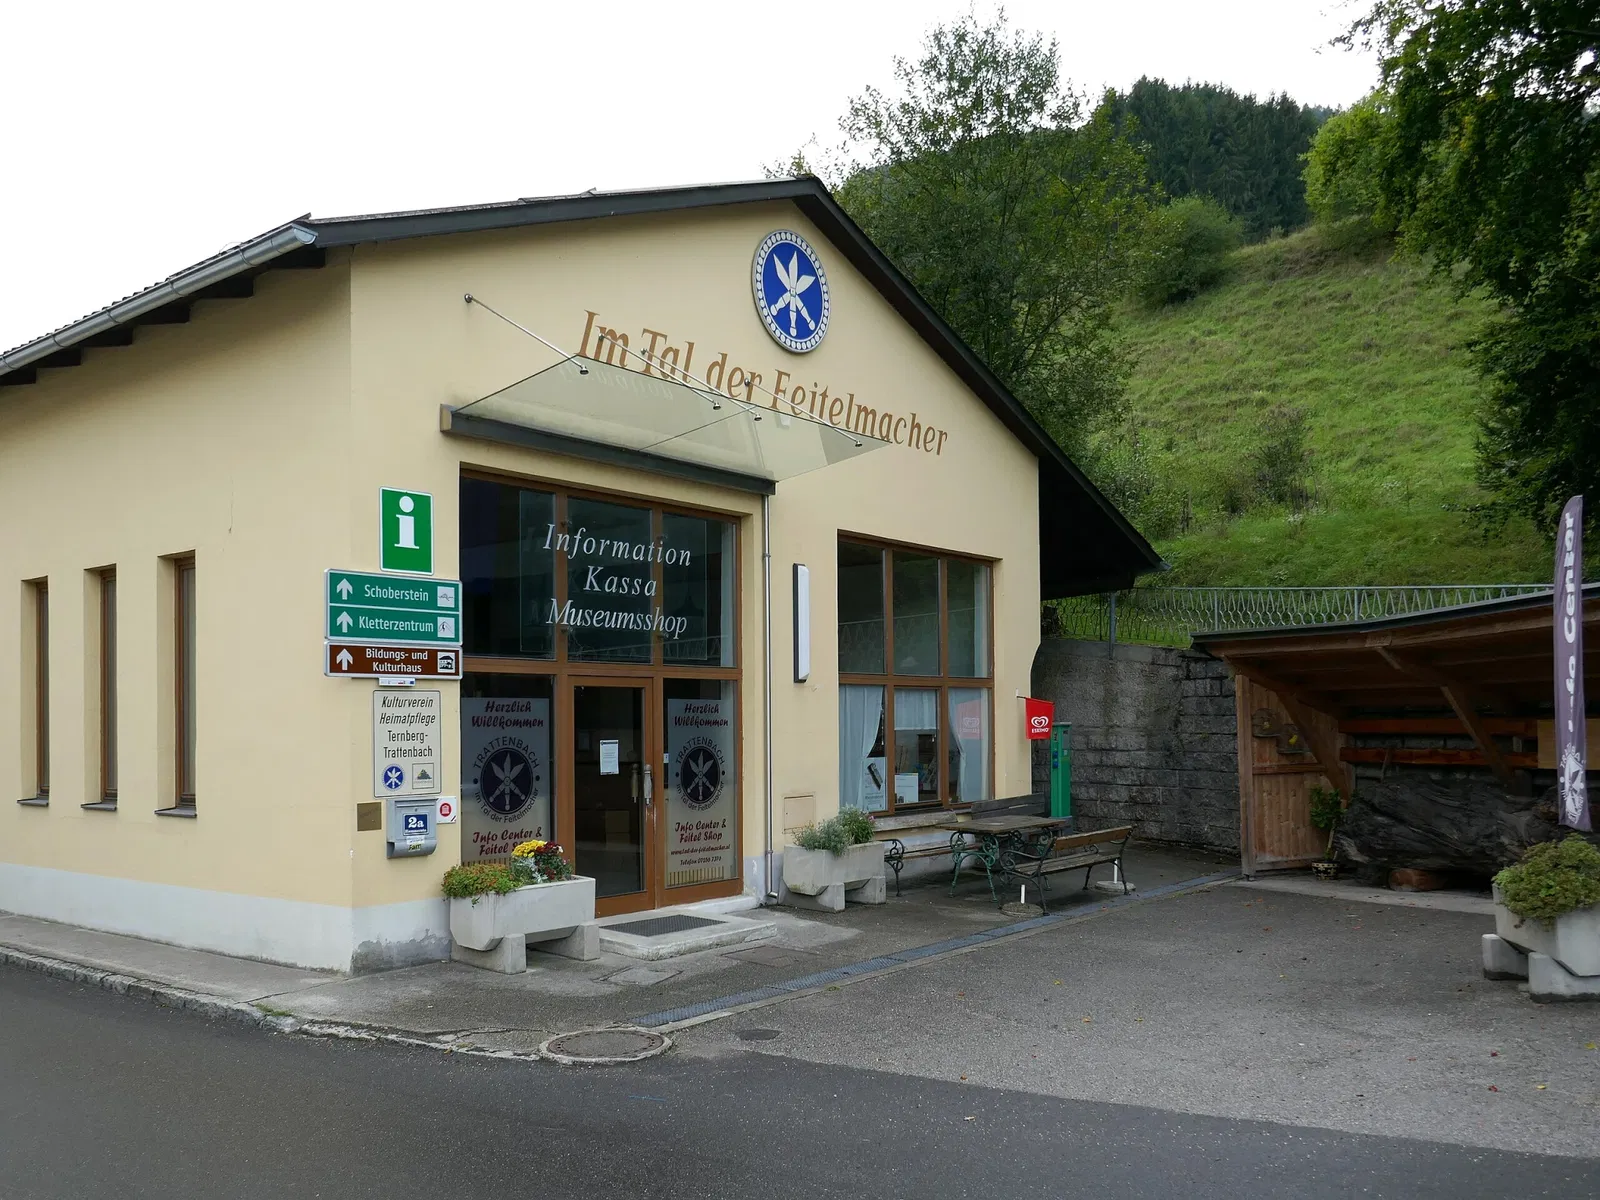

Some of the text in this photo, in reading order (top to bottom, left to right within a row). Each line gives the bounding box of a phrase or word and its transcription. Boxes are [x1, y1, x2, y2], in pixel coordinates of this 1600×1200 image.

[576, 310, 630, 367] Im
[641, 328, 695, 383] Tal
[706, 352, 762, 402] der
[770, 369, 949, 456] Feitelmacher
[542, 523, 691, 566] Information
[583, 565, 658, 597] Kassa
[364, 584, 429, 602] Schoberstein
[358, 616, 434, 633] Kletterzentrum
[546, 598, 688, 639] Museumsshop
[366, 648, 428, 661] Bildungs- und
[372, 661, 422, 673] Kulturhaus
[381, 696, 434, 708] Kulturverein
[484, 700, 532, 713] Herzlich
[684, 703, 720, 714] Herzlich
[379, 712, 436, 727] Heimatpflege
[471, 716, 544, 730] Willkommen
[674, 716, 729, 728] Willkommen
[387, 730, 429, 744] Ternberg-
[383, 746, 433, 759] Trattenbach
[473, 736, 540, 769] TRATTENBACH
[675, 736, 726, 765] TRATTENBACH
[480, 803, 491, 816] Tal
[490, 813, 503, 823] der
[503, 788, 540, 824] Feitelmacher
[408, 814, 425, 829] 2a
[675, 818, 727, 833] Info Center &
[473, 826, 543, 844] Info Center &
[680, 830, 723, 844] Feitel Shop
[479, 842, 509, 856] Feitel
